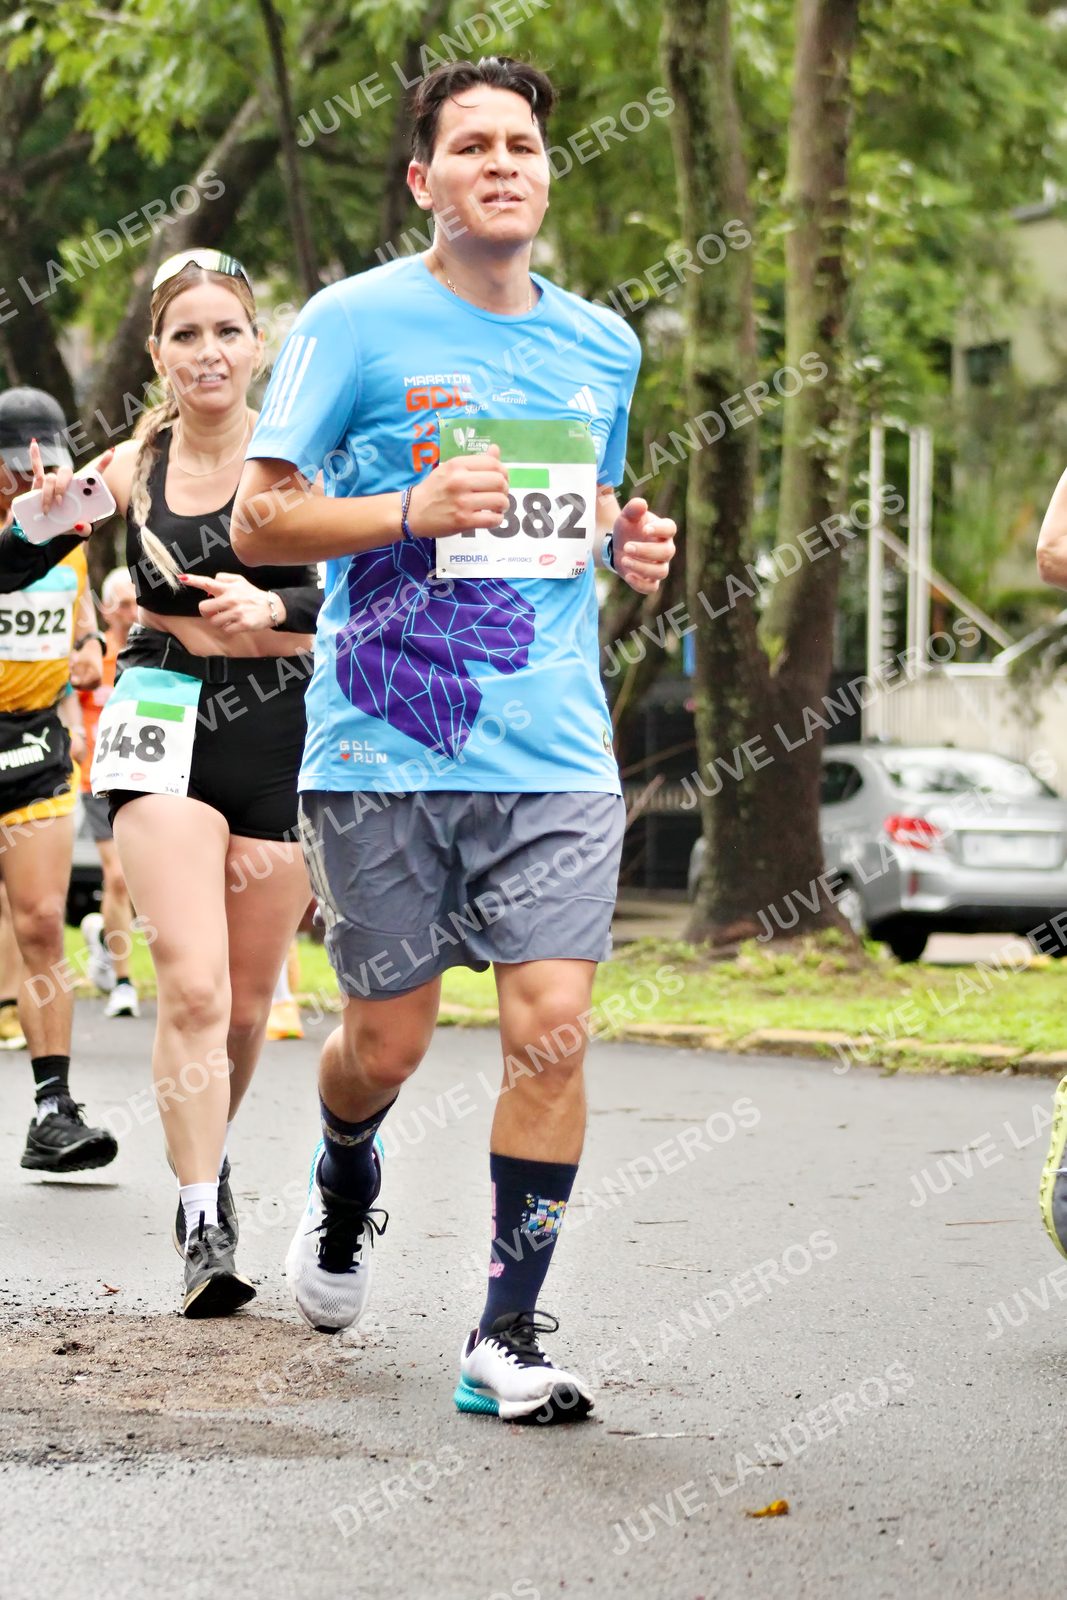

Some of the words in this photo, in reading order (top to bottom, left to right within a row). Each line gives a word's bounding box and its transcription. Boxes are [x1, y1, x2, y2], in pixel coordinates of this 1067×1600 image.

[461, 492, 587, 540] 882
[449, 555, 489, 563] PERDURA
[0, 608, 67, 637] 5922
[96, 723, 166, 763] 348
[340, 740, 375, 752] GDL
[353, 752, 388, 764] RUN
